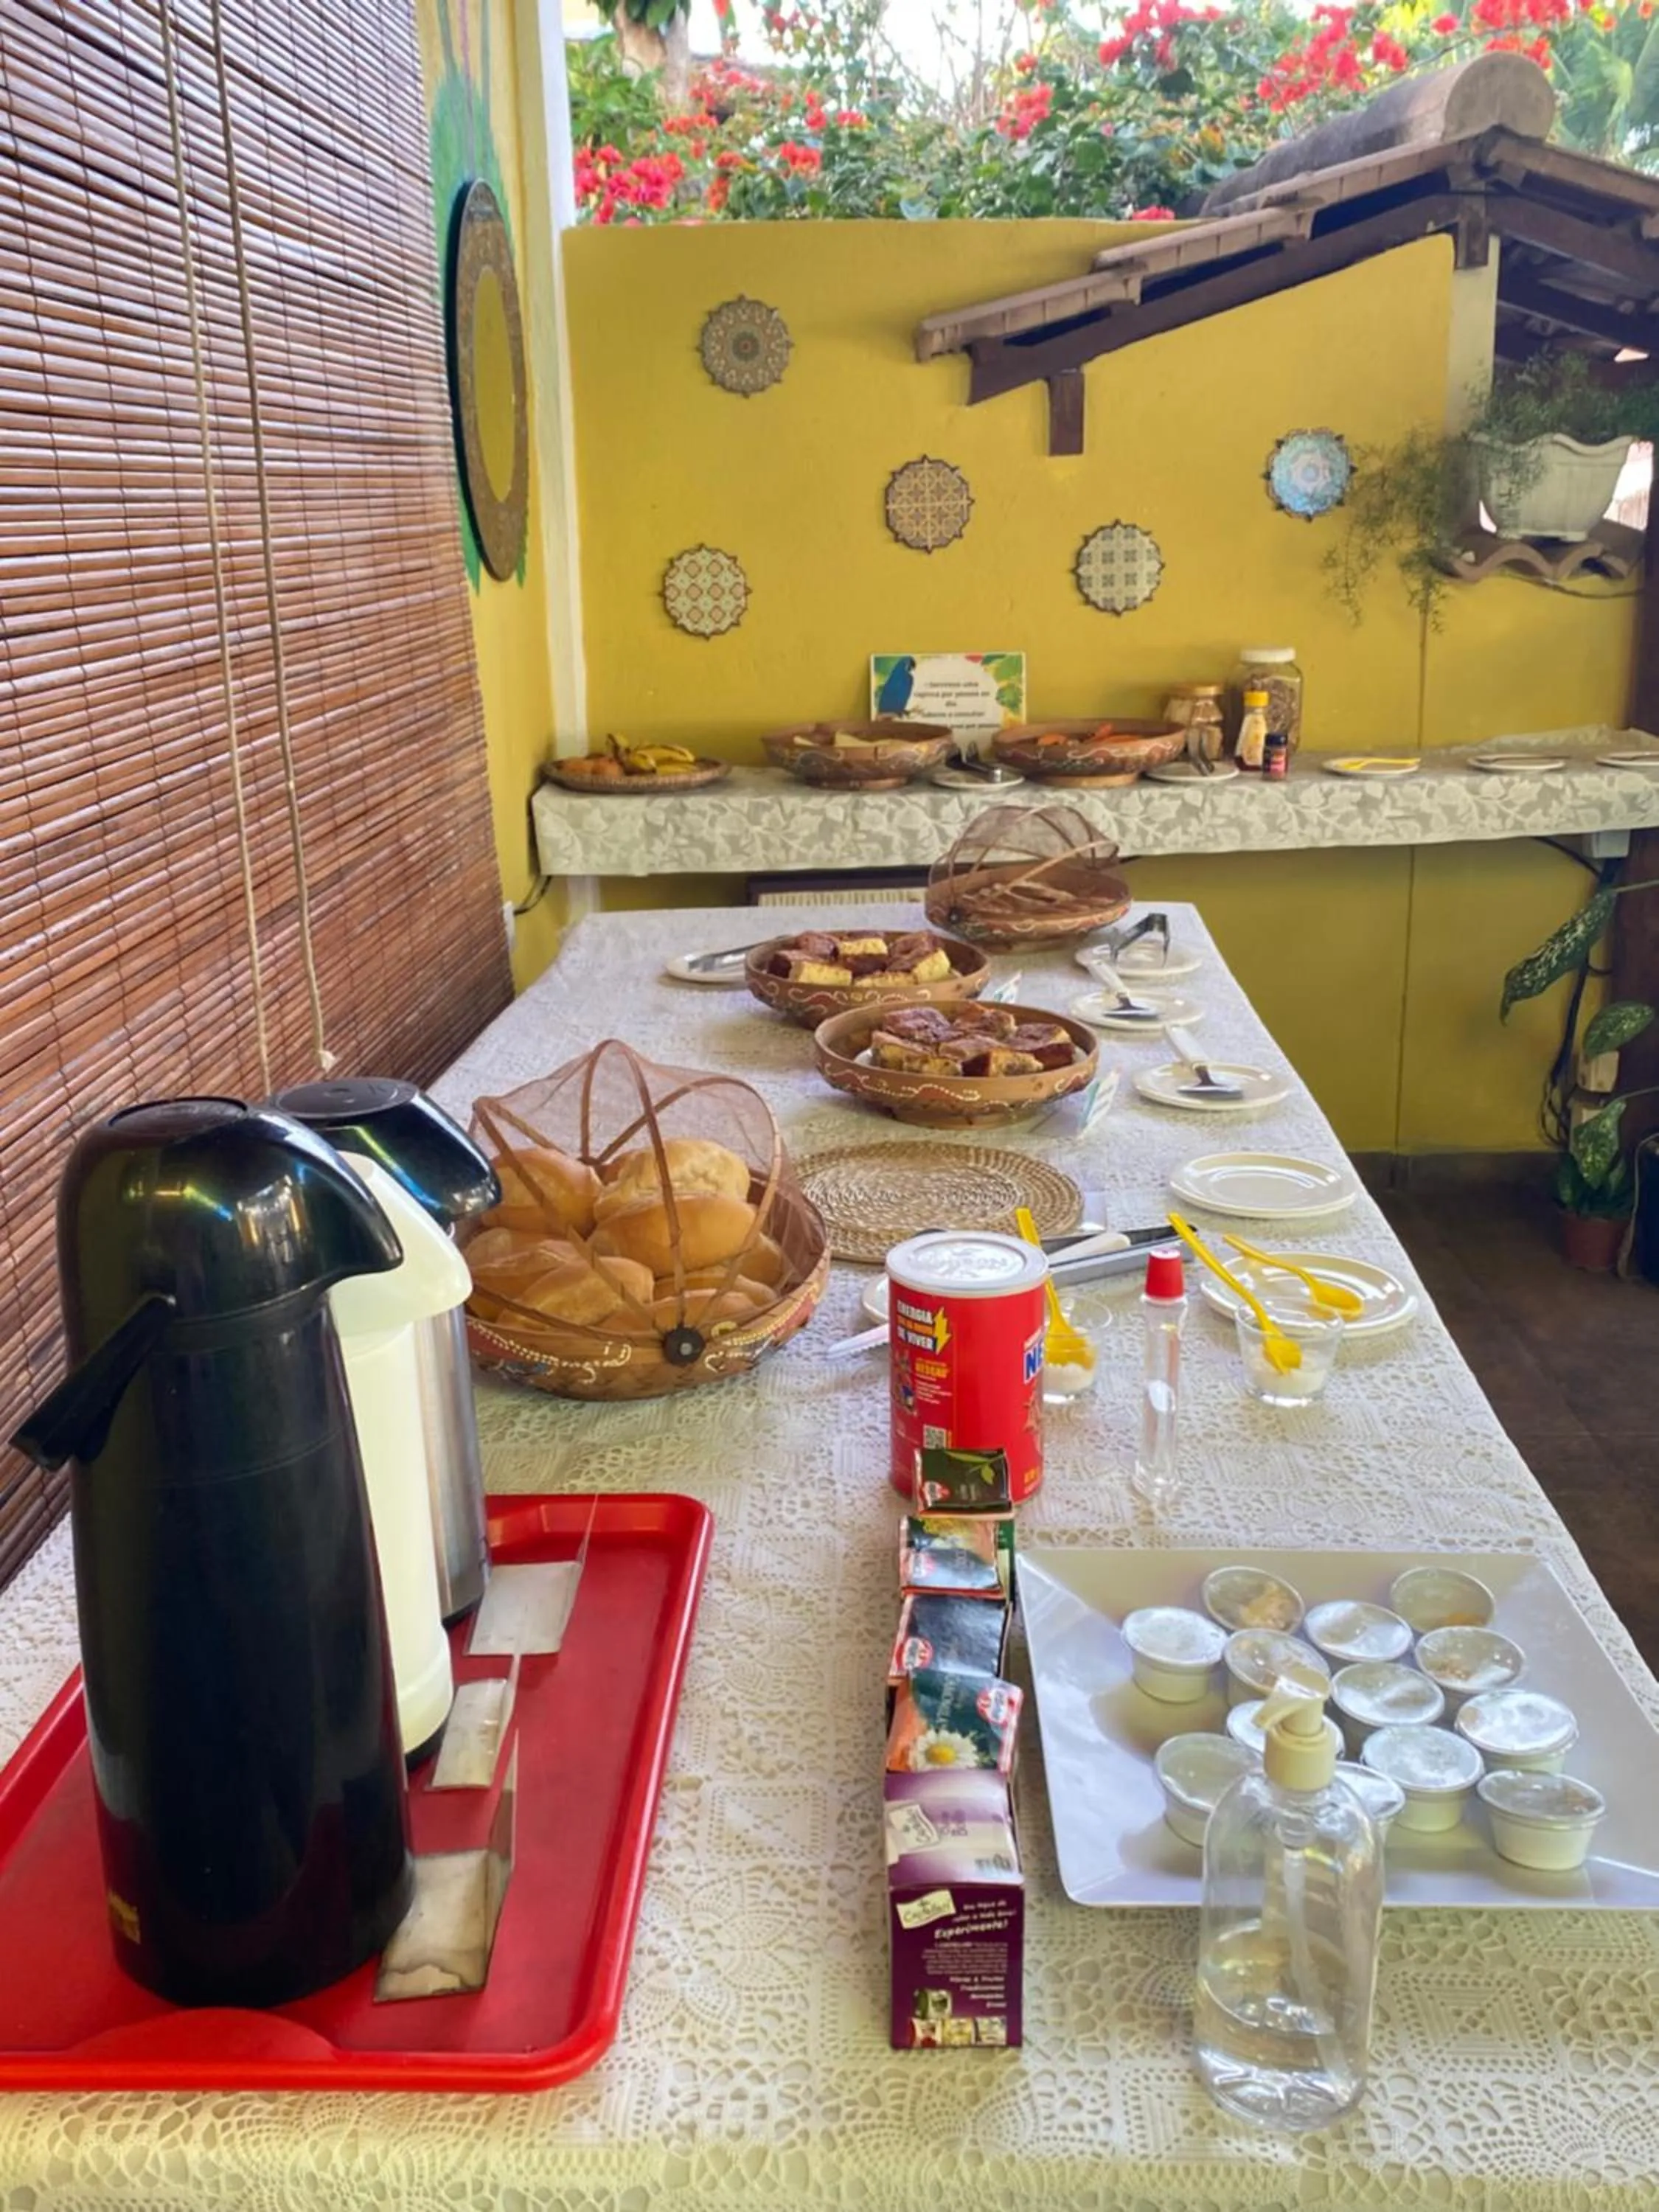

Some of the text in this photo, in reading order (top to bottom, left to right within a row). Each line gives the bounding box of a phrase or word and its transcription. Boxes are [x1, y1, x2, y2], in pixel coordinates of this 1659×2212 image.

[897, 1299, 933, 1325] ENERGIA
[906, 1331, 934, 1351] VIVER
[934, 1919, 1009, 1941] Experimente!
